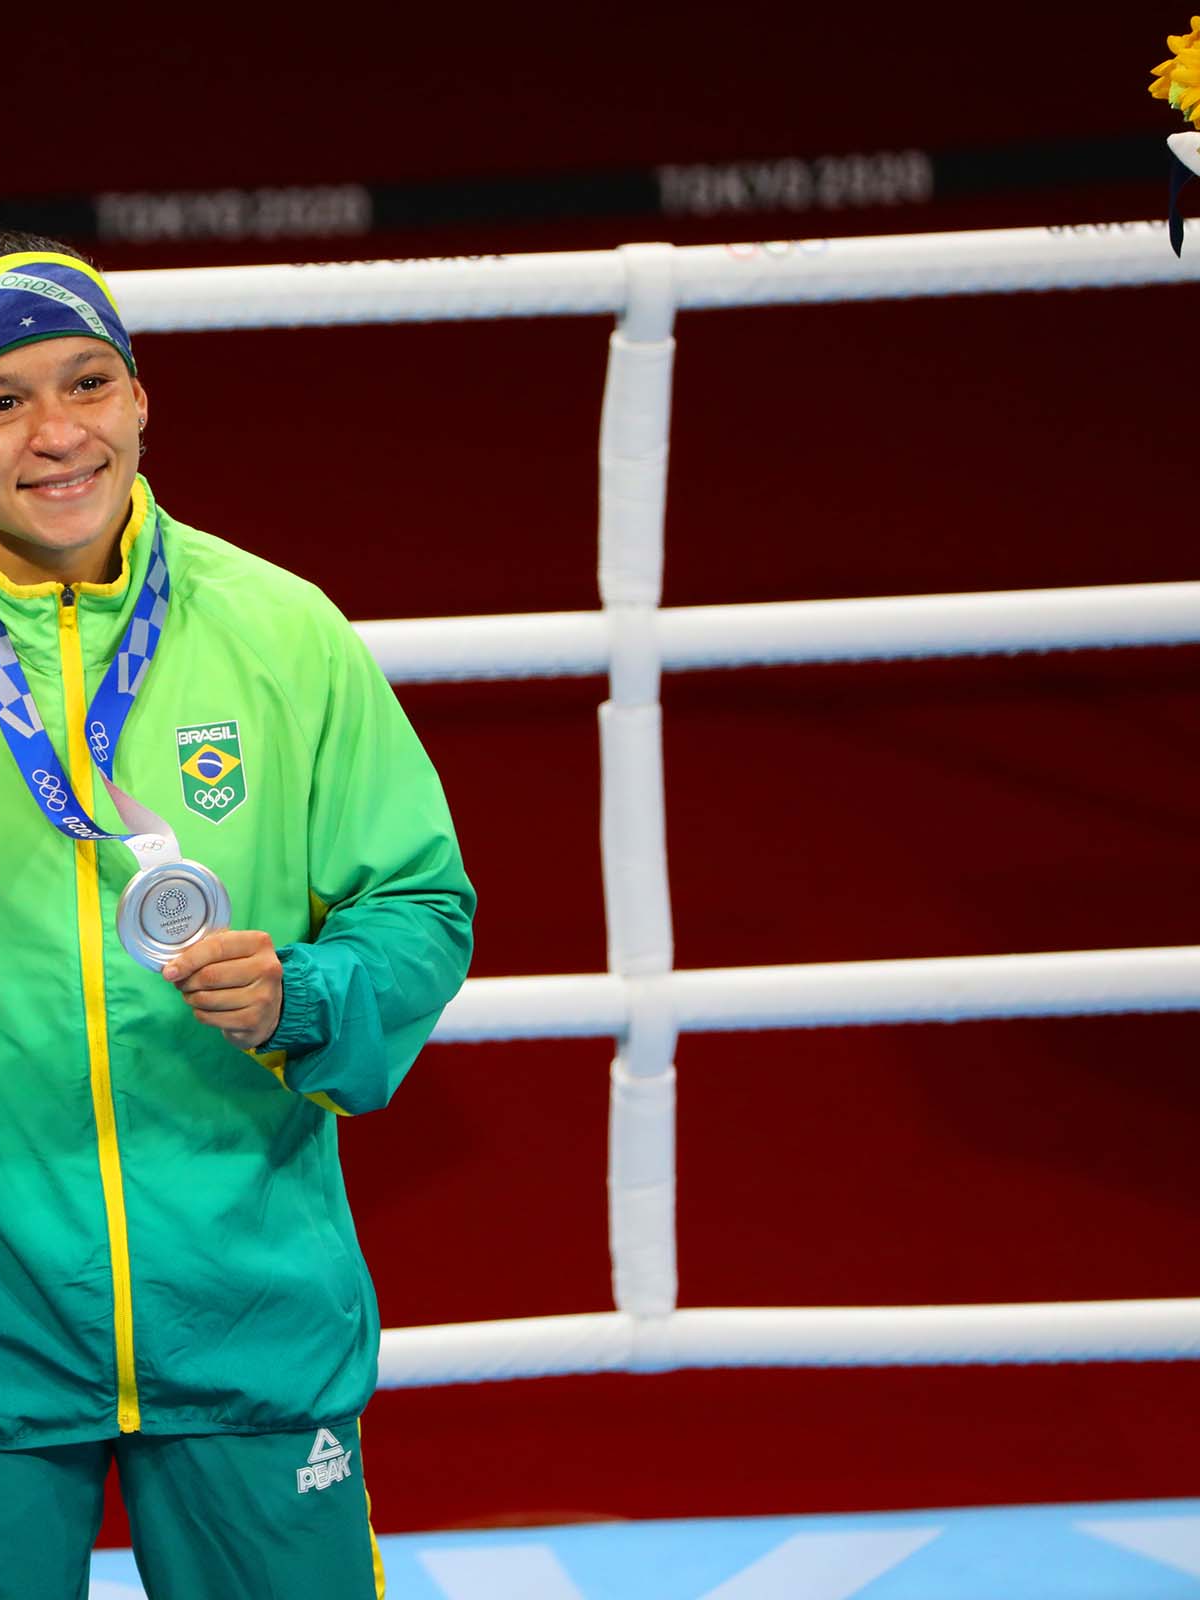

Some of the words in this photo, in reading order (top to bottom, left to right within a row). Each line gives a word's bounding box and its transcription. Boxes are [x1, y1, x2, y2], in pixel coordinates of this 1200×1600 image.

[0, 275, 75, 303] ORDEM
[75, 303, 92, 314] E
[178, 726, 237, 745] BRASIL
[296, 1450, 352, 1494] PEAK
